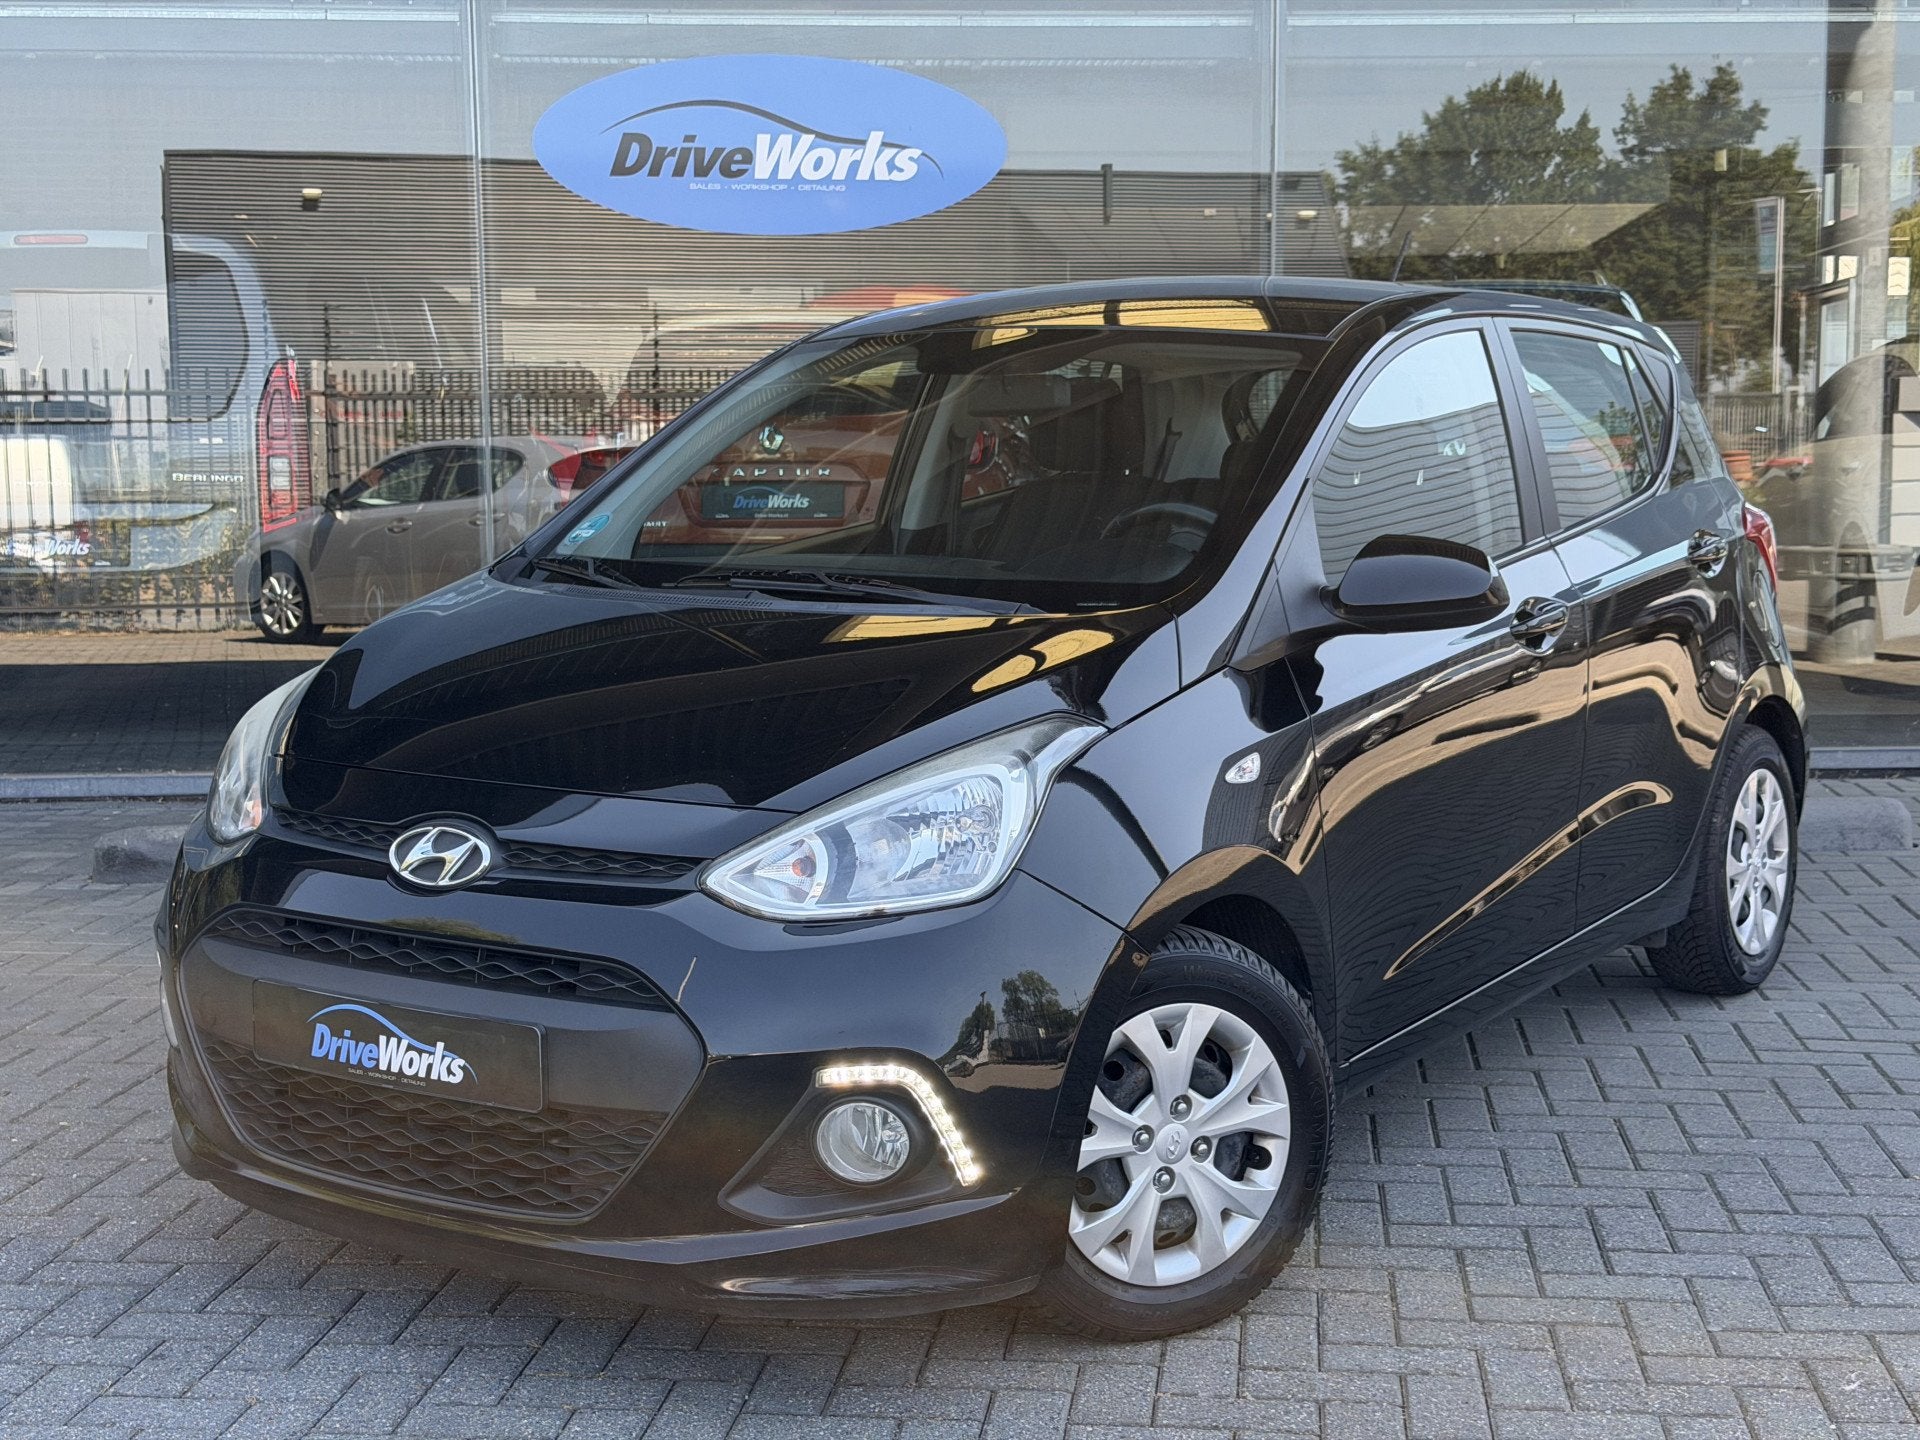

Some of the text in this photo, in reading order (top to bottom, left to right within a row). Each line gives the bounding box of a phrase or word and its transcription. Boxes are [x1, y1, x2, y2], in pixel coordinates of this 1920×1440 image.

[609, 130, 923, 182] DriveWorks
[731, 183, 788, 191] WORKSHOP
[798, 184, 847, 192] DETAILING
[733, 493, 810, 509] DriveWorks
[311, 1022, 466, 1084] DriveWorks
